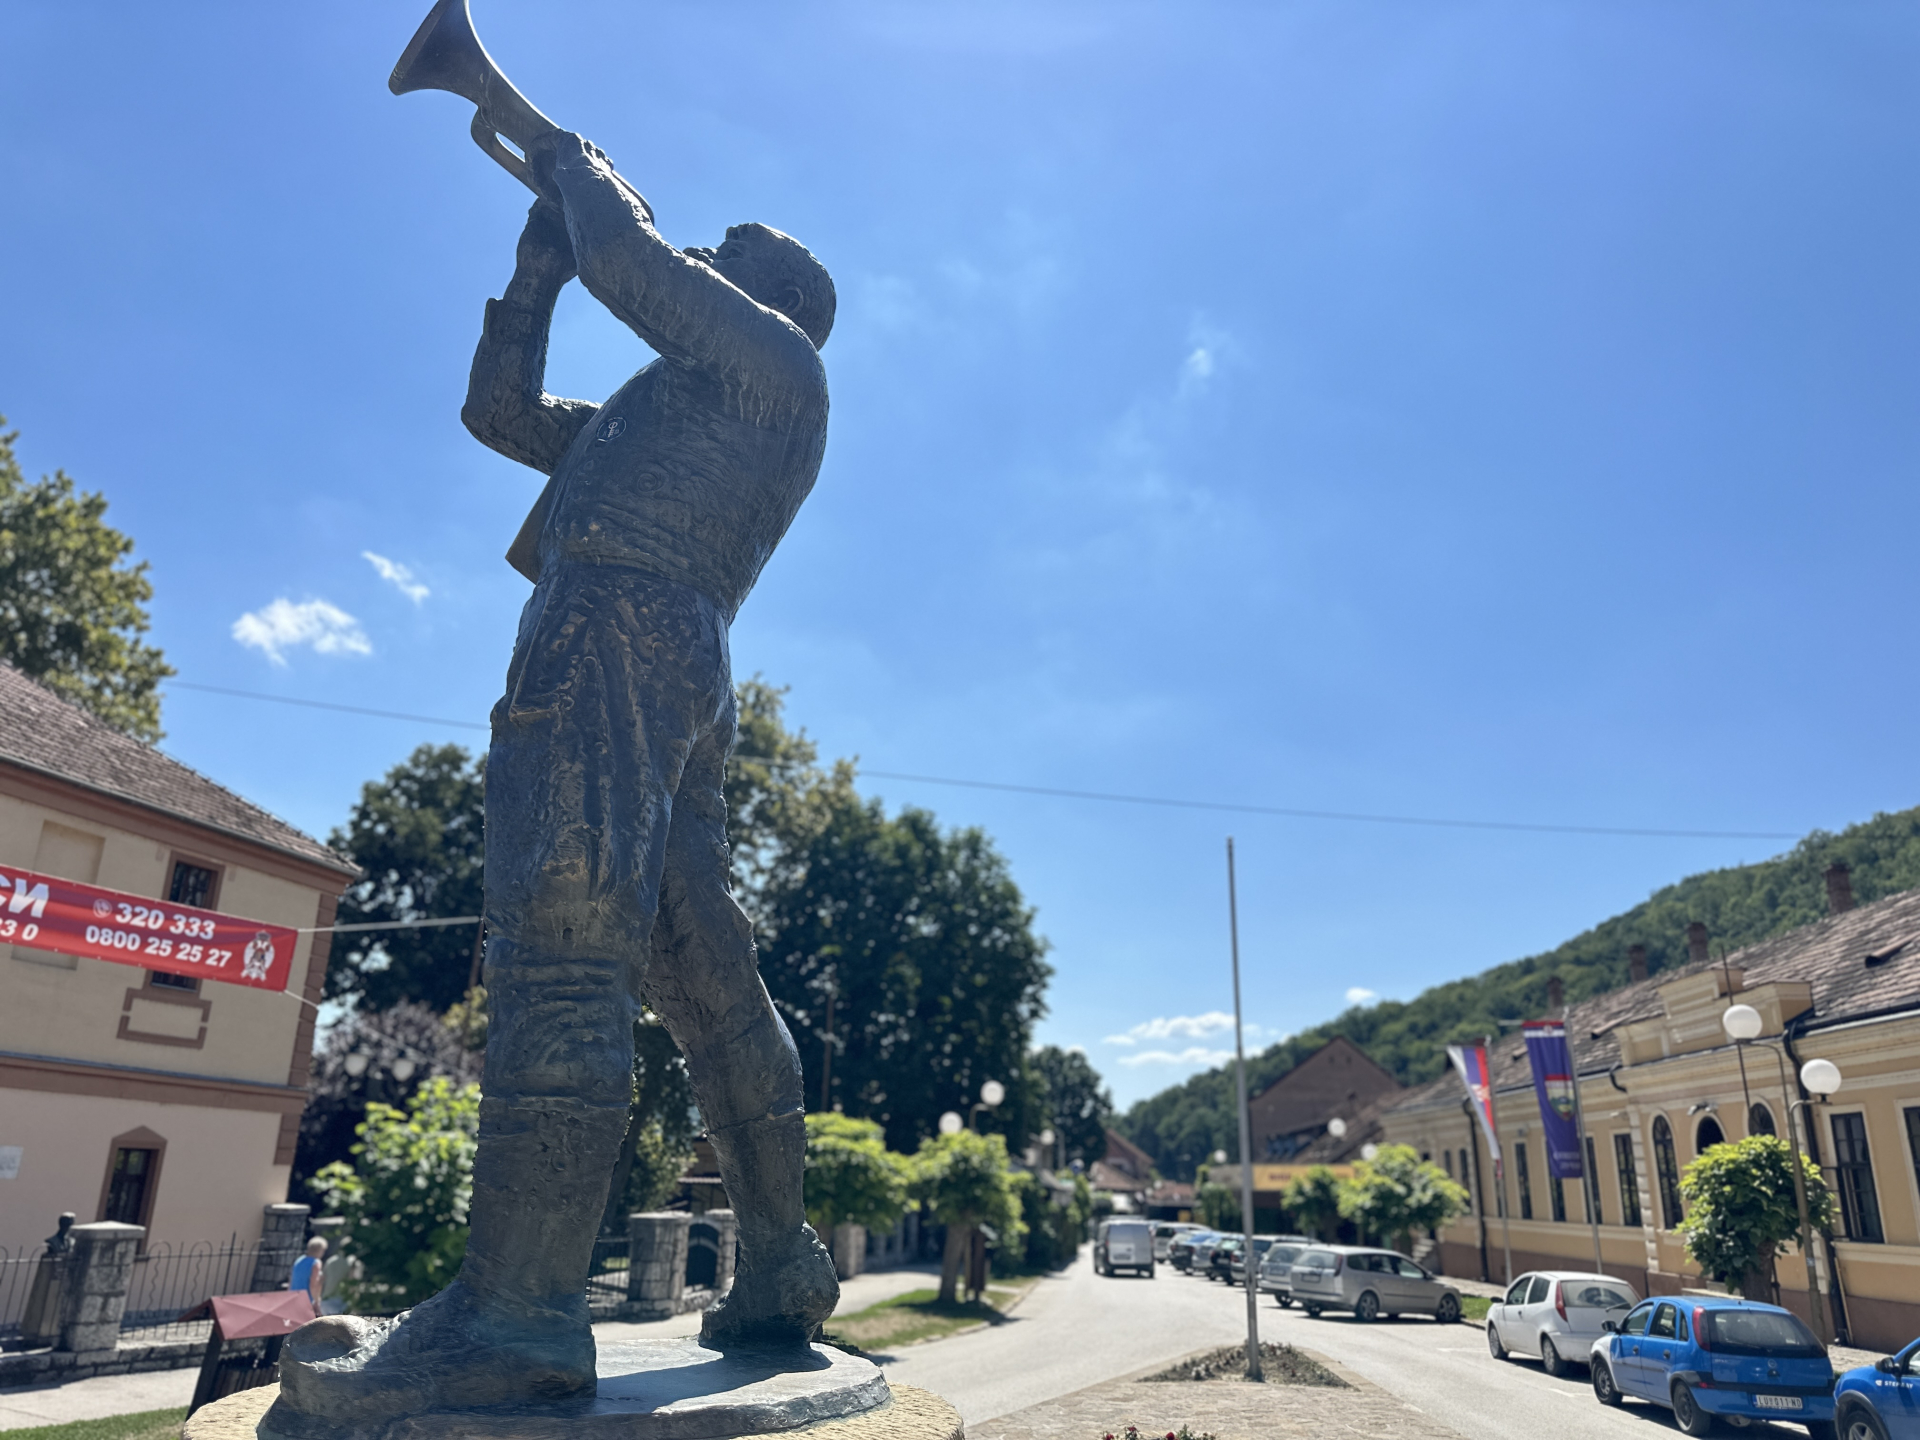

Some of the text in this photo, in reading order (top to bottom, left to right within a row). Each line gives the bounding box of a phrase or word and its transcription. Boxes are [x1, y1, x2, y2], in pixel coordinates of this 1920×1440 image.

[0, 918, 18, 937] 3
[115, 903, 216, 940] 320 333
[85, 925, 232, 967] 0800 25 25 27
